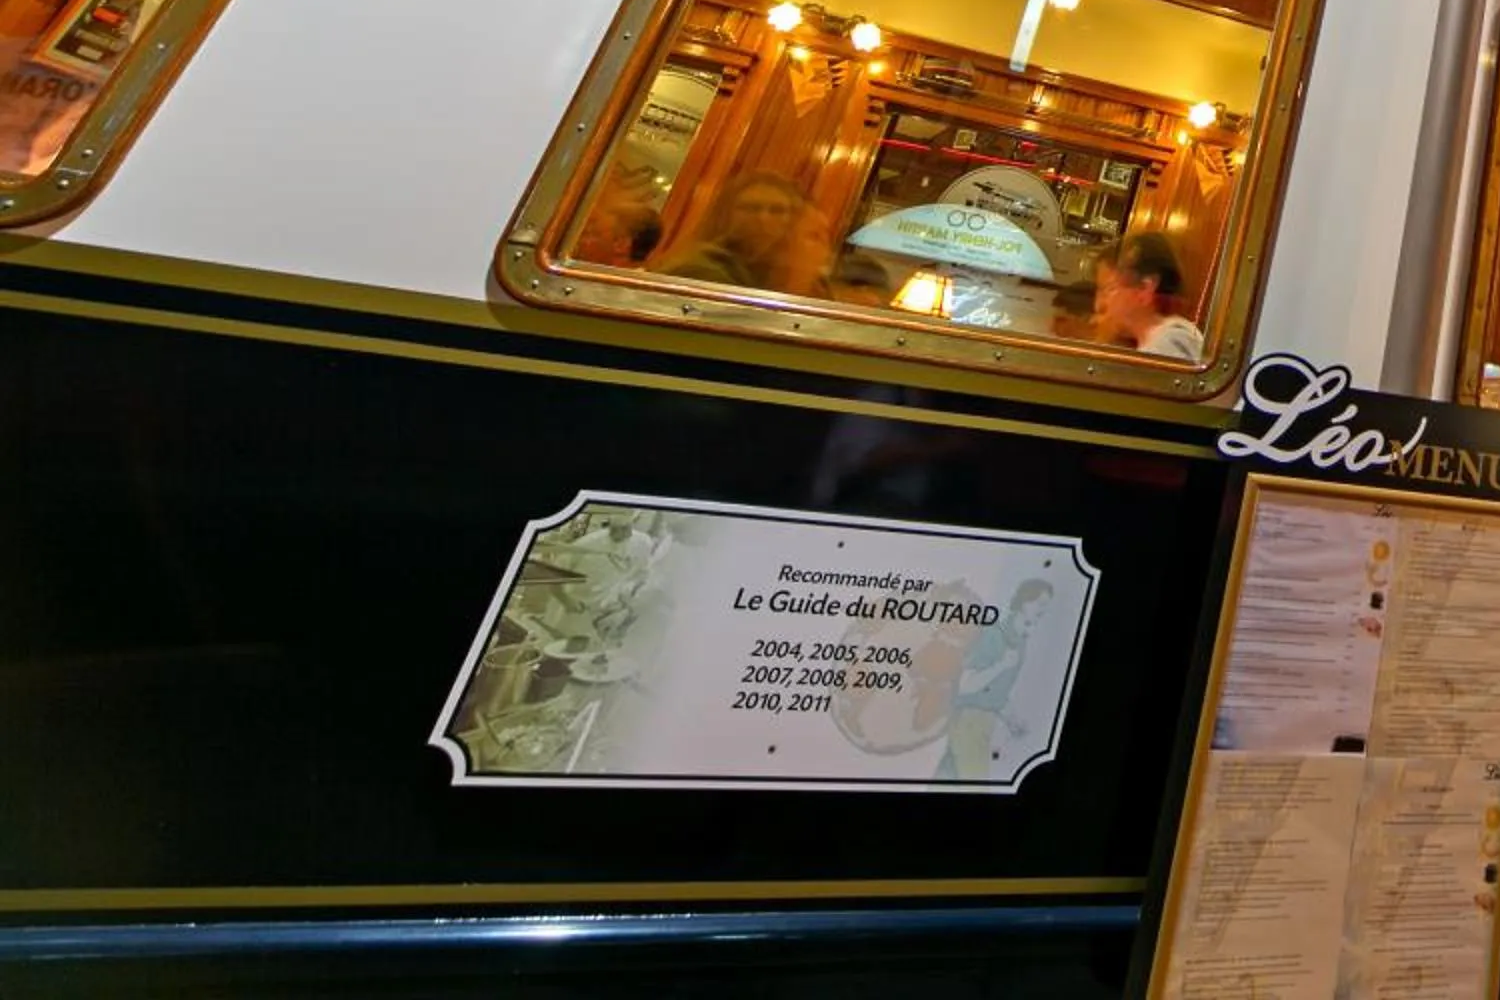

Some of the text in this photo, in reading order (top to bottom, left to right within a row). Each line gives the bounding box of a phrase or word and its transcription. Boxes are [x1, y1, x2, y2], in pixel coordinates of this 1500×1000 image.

[1217, 353, 1428, 473] Léo
[778, 564, 934, 594] Recommandé par
[733, 587, 1000, 627] Le Guide du ROUTARD
[751, 639, 914, 668] 2004, 2005, 2006,
[741, 665, 904, 693] 2007, 2008, 2009,
[732, 691, 832, 715] 2010, 2011
